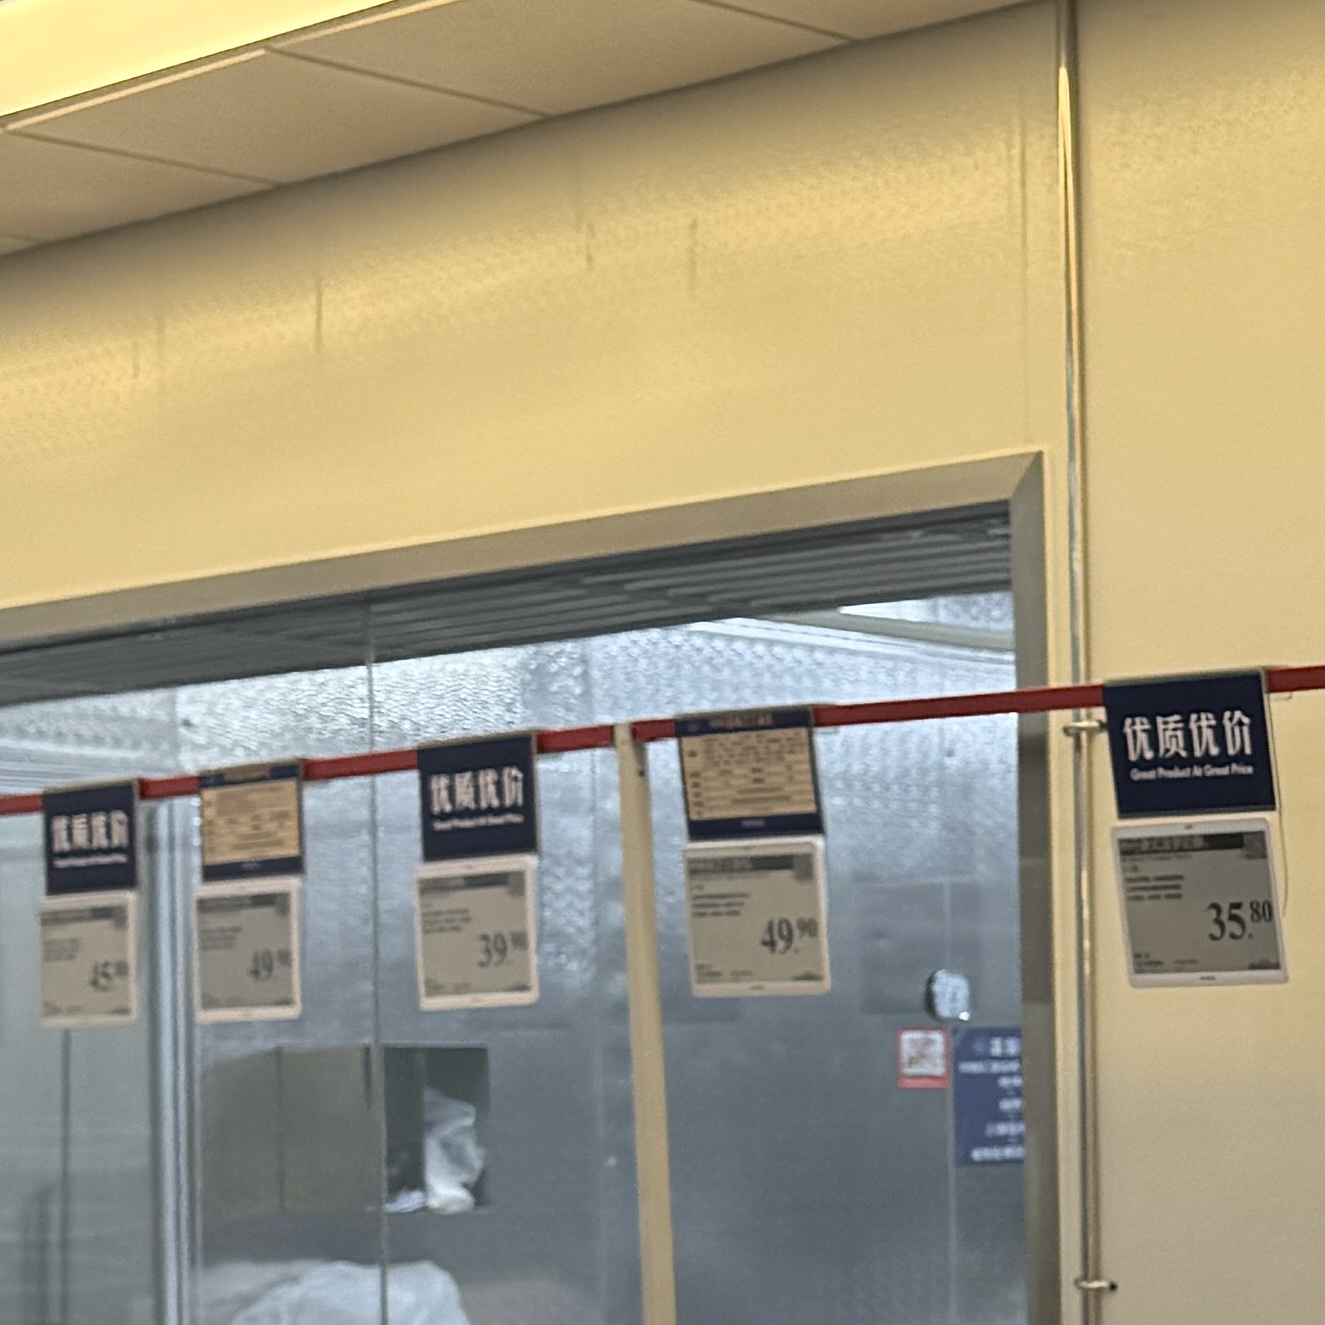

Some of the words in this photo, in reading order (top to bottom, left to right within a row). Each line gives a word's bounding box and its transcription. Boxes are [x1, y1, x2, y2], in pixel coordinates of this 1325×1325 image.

[1123, 710, 1252, 761] 优质优价
[1207, 900, 1273, 941] 35.80
